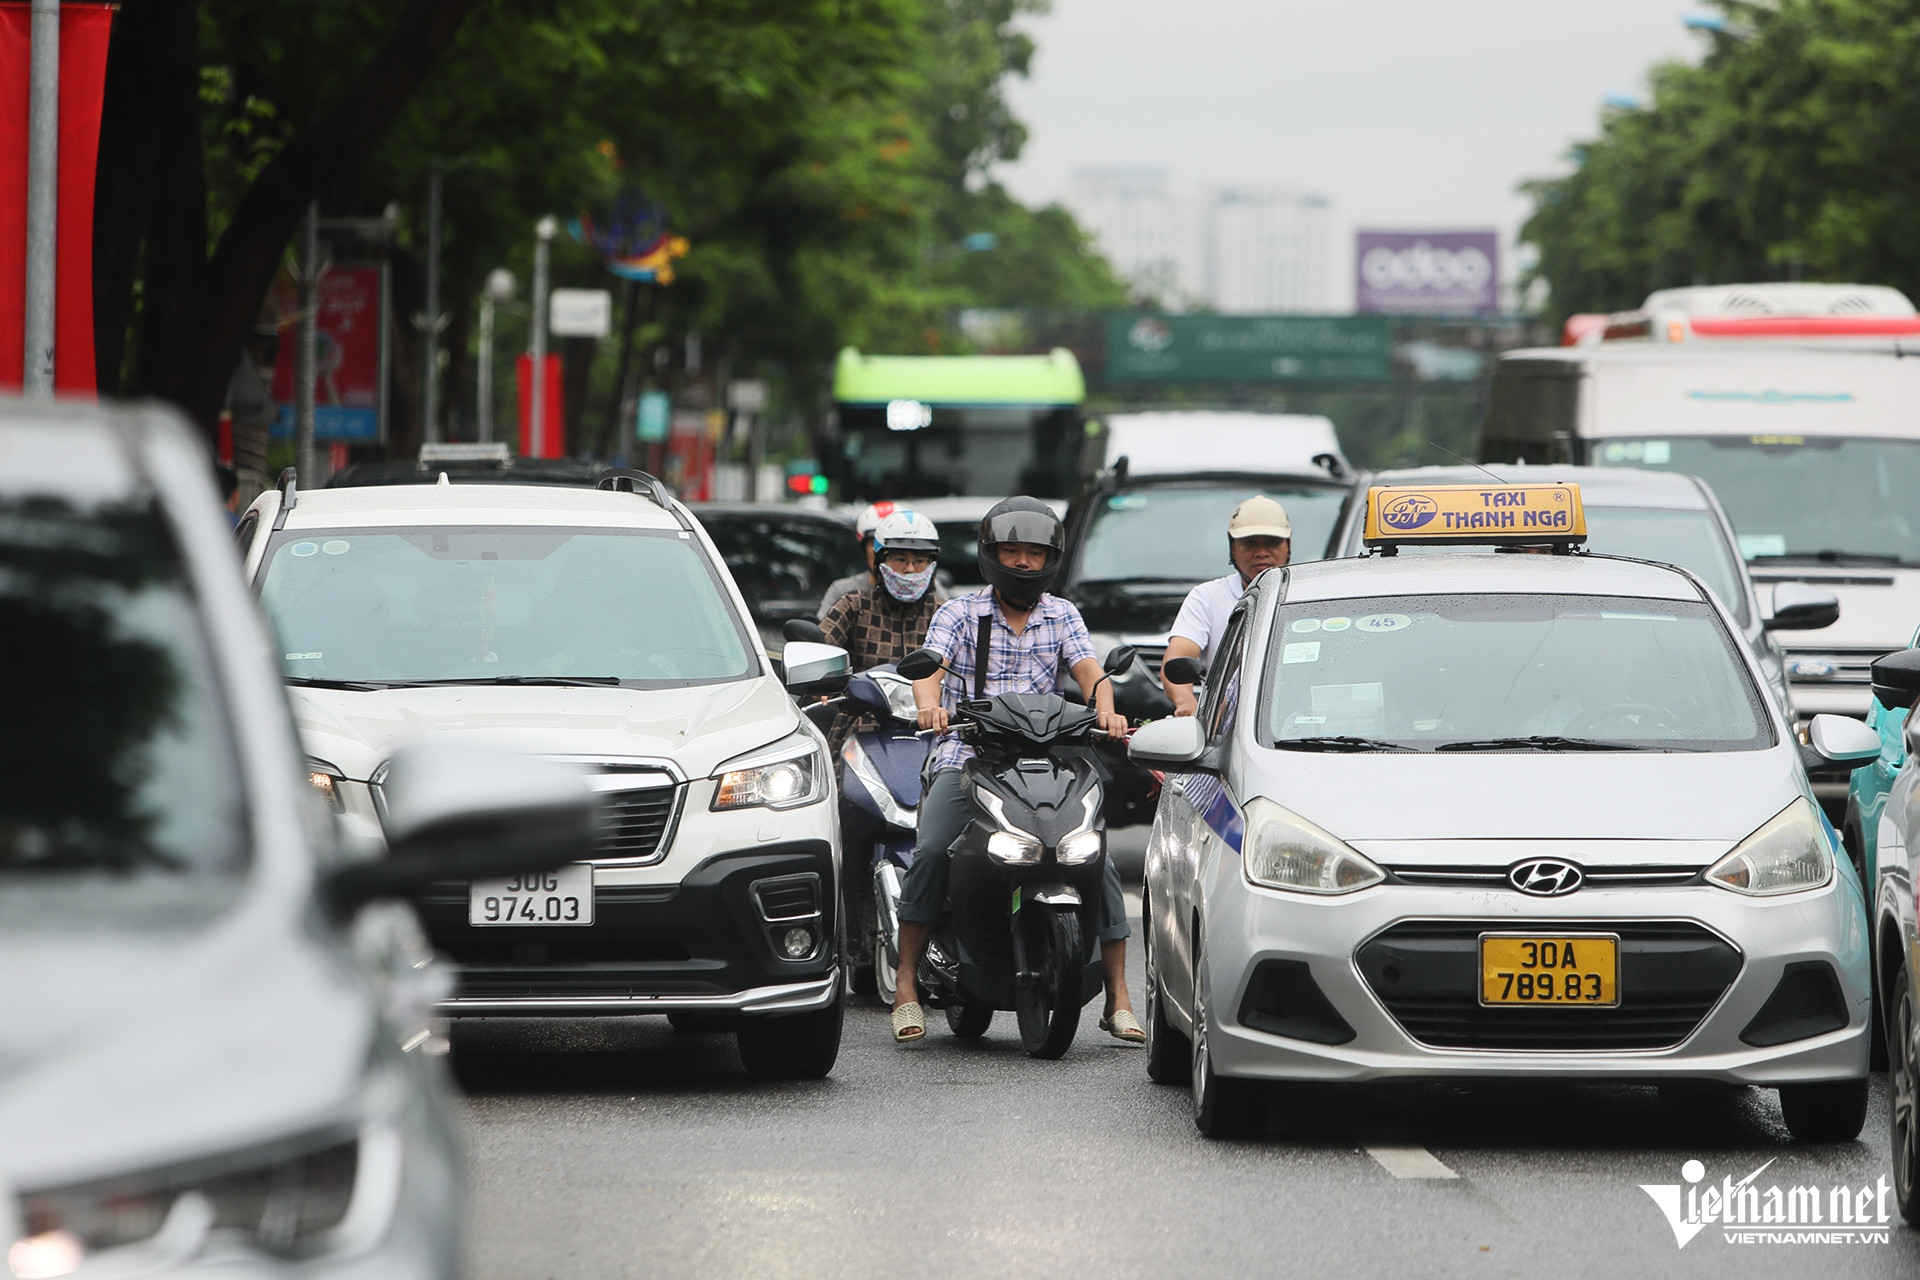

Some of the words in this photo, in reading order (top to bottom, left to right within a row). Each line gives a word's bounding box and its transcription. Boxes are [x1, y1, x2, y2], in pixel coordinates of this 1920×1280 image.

[1480, 492, 1526, 507] TAXI
[1442, 511, 1515, 529] THANH
[1523, 510, 1567, 528] NGA
[1369, 617, 1396, 628] 45
[484, 897, 579, 921] 974.03
[1521, 942, 1577, 968] 30A
[1497, 973, 1602, 1000] 789.83
